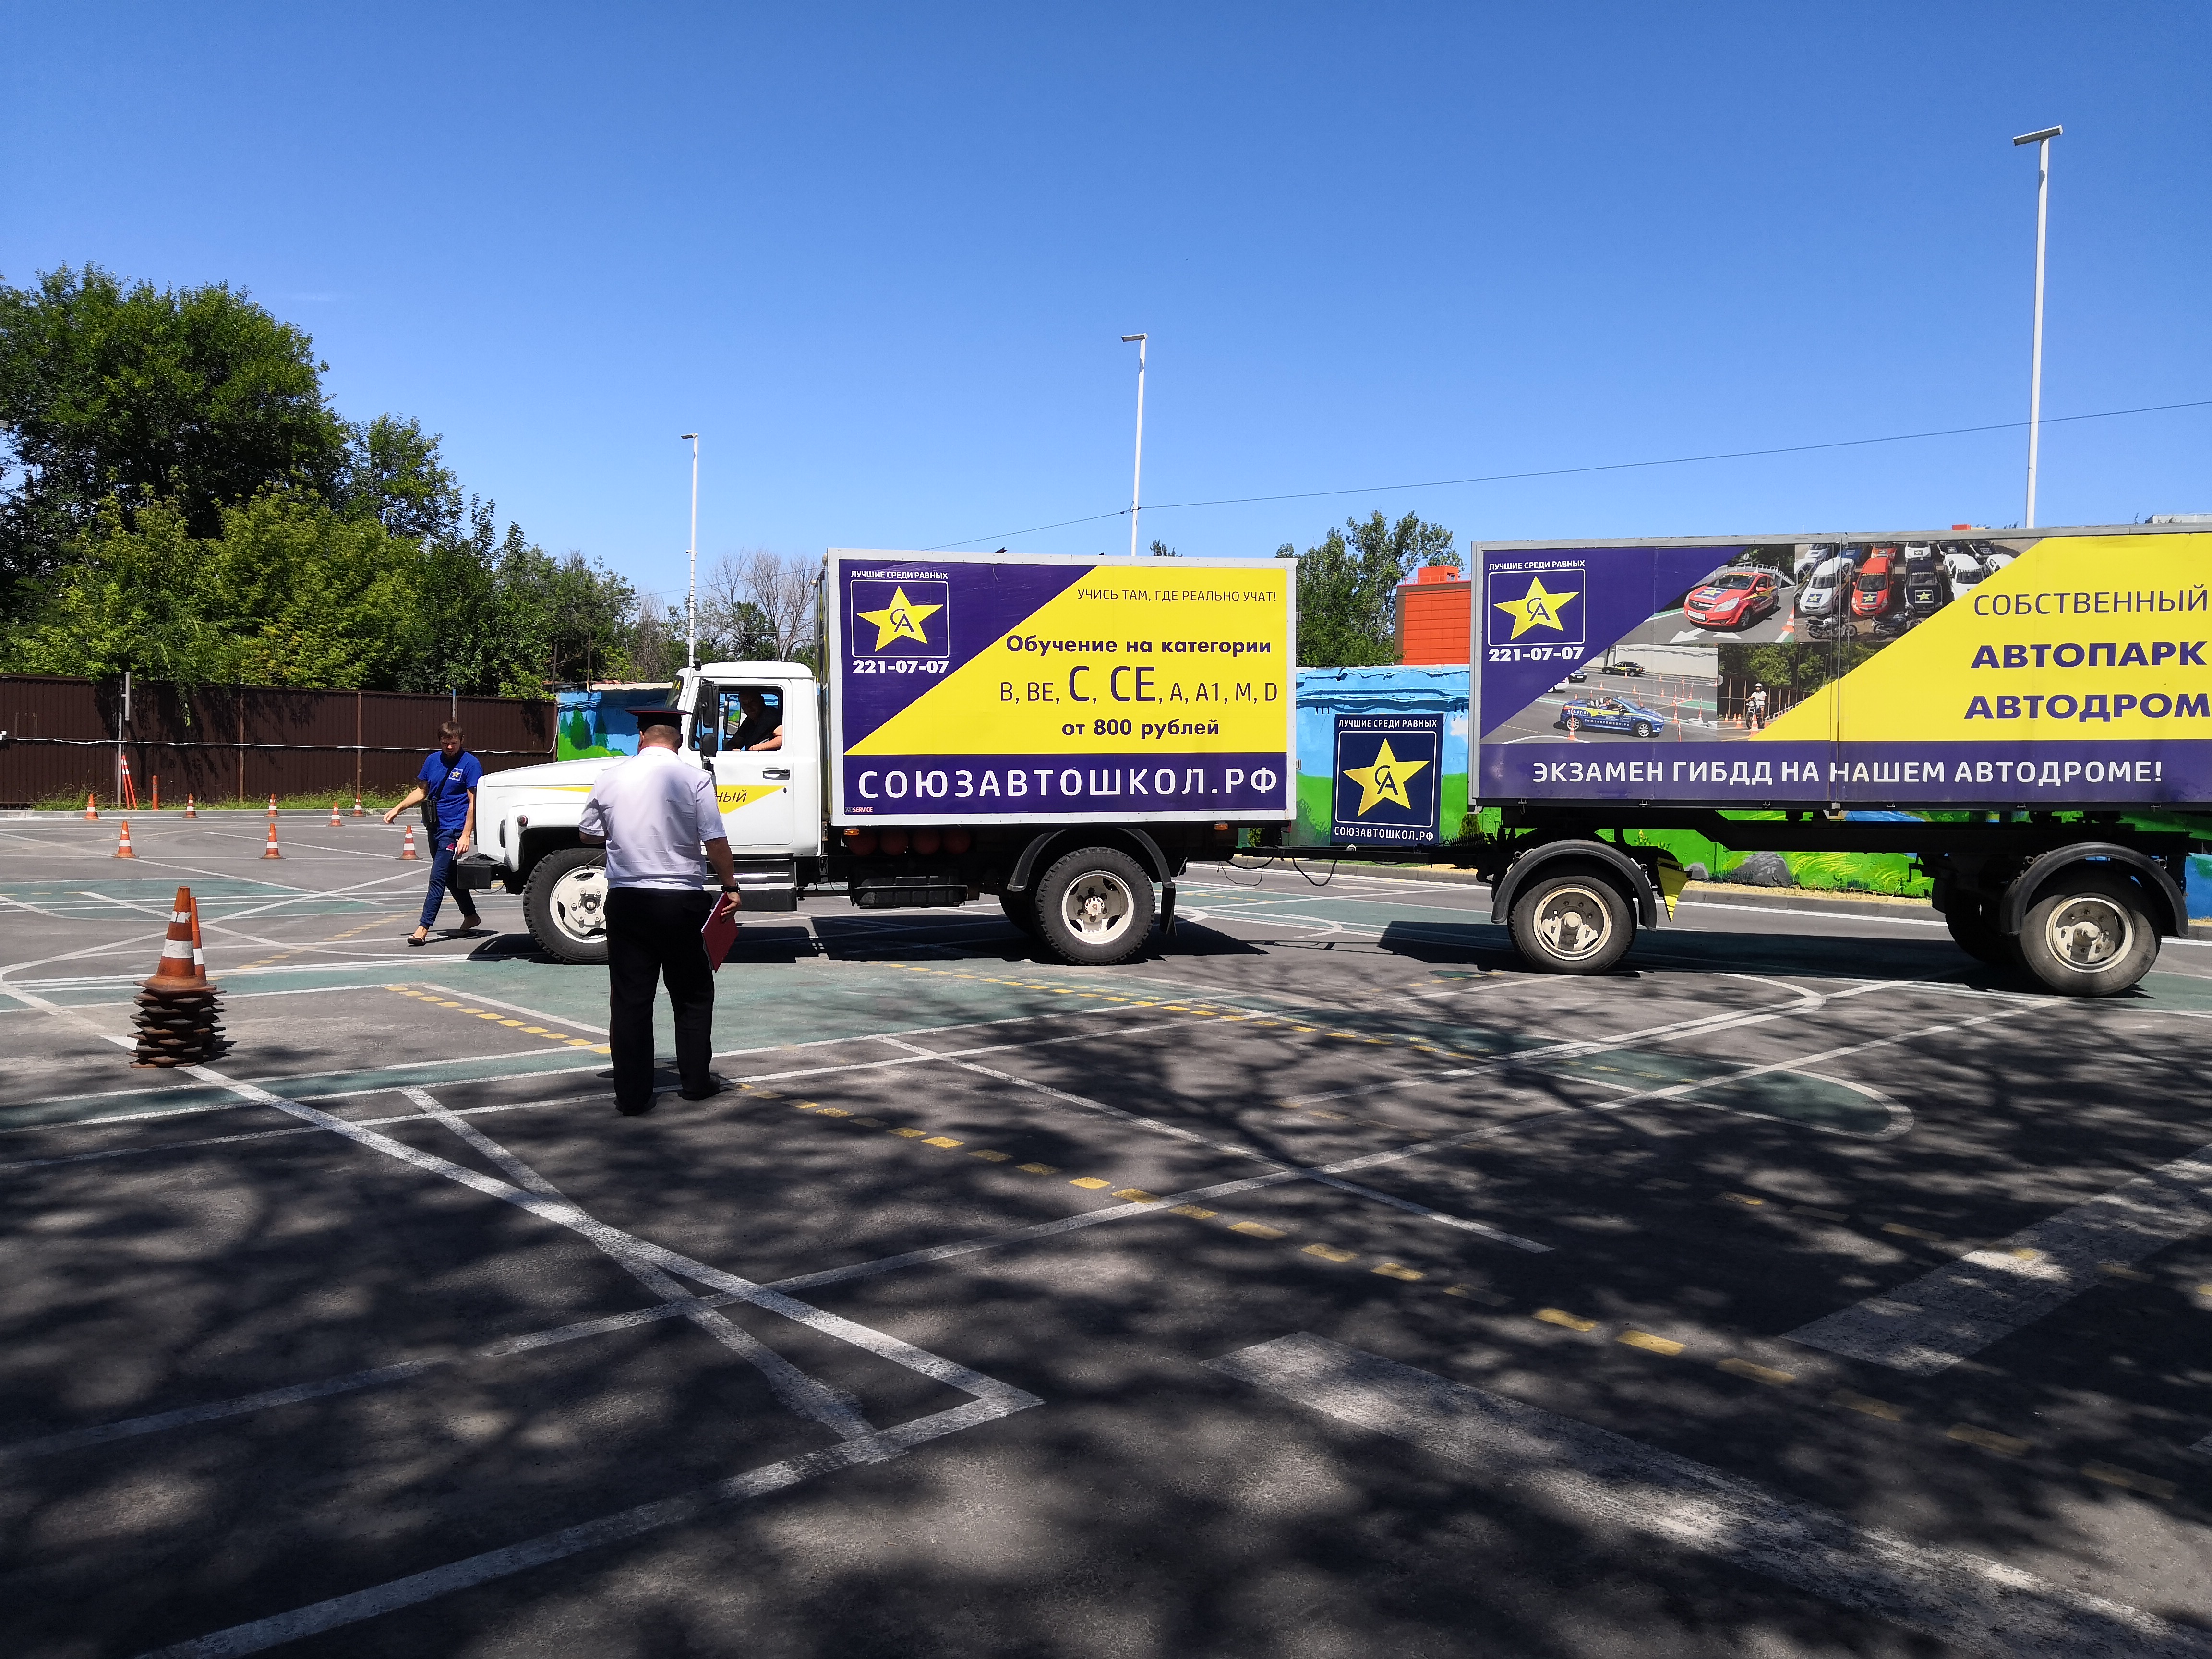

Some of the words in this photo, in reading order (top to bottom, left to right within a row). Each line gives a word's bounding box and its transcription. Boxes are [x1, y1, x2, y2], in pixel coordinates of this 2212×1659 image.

[887, 571, 913, 579] СРЕДИ
[1489, 562, 1522, 570] ЛУЧШИЕ
[1078, 589, 1118, 600] УЧИСЬ
[1122, 590, 1152, 602] ТАМ,
[1155, 591, 1178, 602] ГДЕ
[1182, 591, 1239, 601] РЕАЛЬНО
[1243, 591, 1277, 602] УЧАТ!
[1974, 584, 2207, 616] СОБСТВЕННЫЙ
[1006, 635, 1118, 656] Обучение
[1126, 641, 1153, 653] на
[1162, 640, 1271, 657] категории
[1488, 647, 1585, 661] 221-07-07
[1971, 641, 2207, 668] АВТОПАРК
[853, 660, 950, 673] 221-07-07
[1265, 683, 1277, 701] D
[1964, 693, 2211, 722] АВТОДРОМ
[1062, 724, 1085, 735] от
[1093, 719, 1132, 735] 800
[1141, 719, 1219, 739] рублей
[1338, 719, 1371, 728] ЛУЧШИЕ
[1373, 720, 1400, 729] СРЕДИ
[1402, 719, 1437, 727] РАВНЫХ
[858, 767, 1277, 799] СОЮЗАВТОШКОЛ.РФ
[1533, 761, 1663, 783] ЭКЗАМЕН
[1673, 761, 1773, 785] ГИБДД
[1782, 761, 1819, 782] НА
[1830, 761, 1944, 783] НАШЕМ
[1954, 761, 2161, 787] АВТОДРОМЕ!
[1334, 826, 1434, 841] СОЮЗАВТОШКОЛ.РФ
